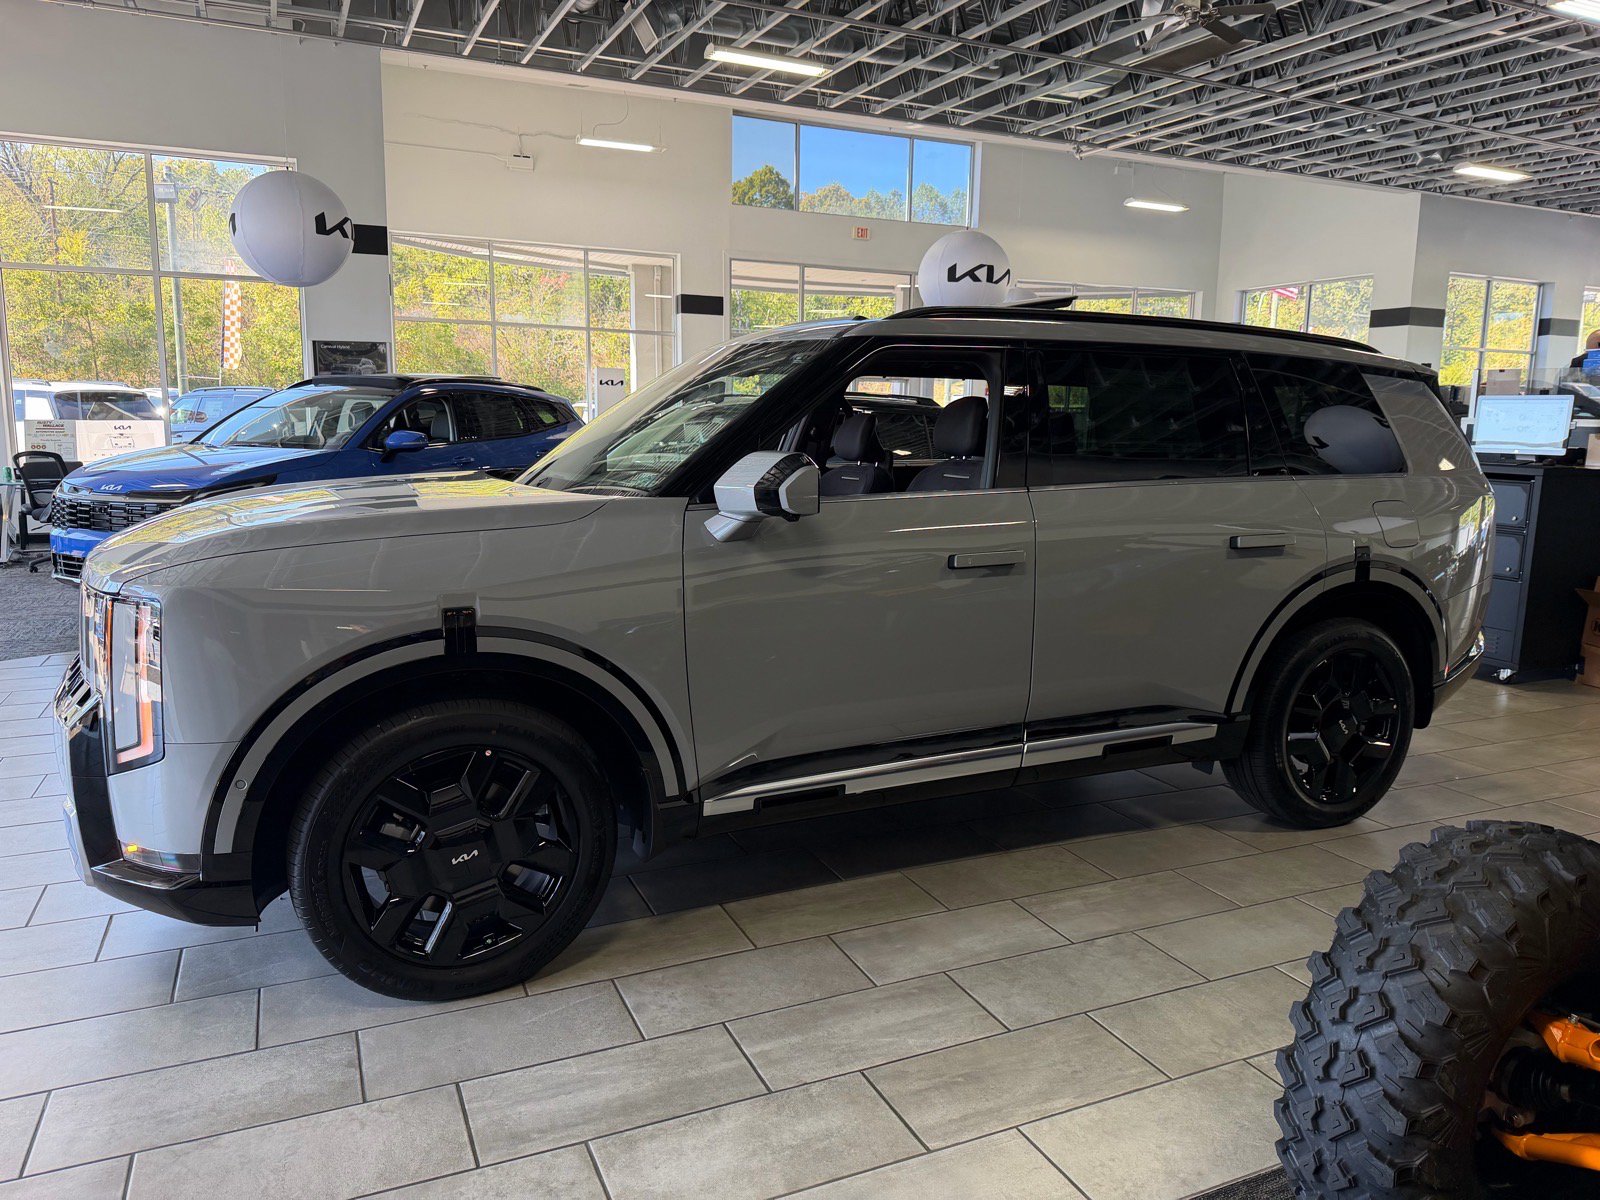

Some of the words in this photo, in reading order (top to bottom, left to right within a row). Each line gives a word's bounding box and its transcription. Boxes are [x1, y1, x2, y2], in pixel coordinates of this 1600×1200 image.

[856, 225, 868, 239] EXIT
[100, 483, 123, 491] KIA
[451, 849, 479, 865] KIA
